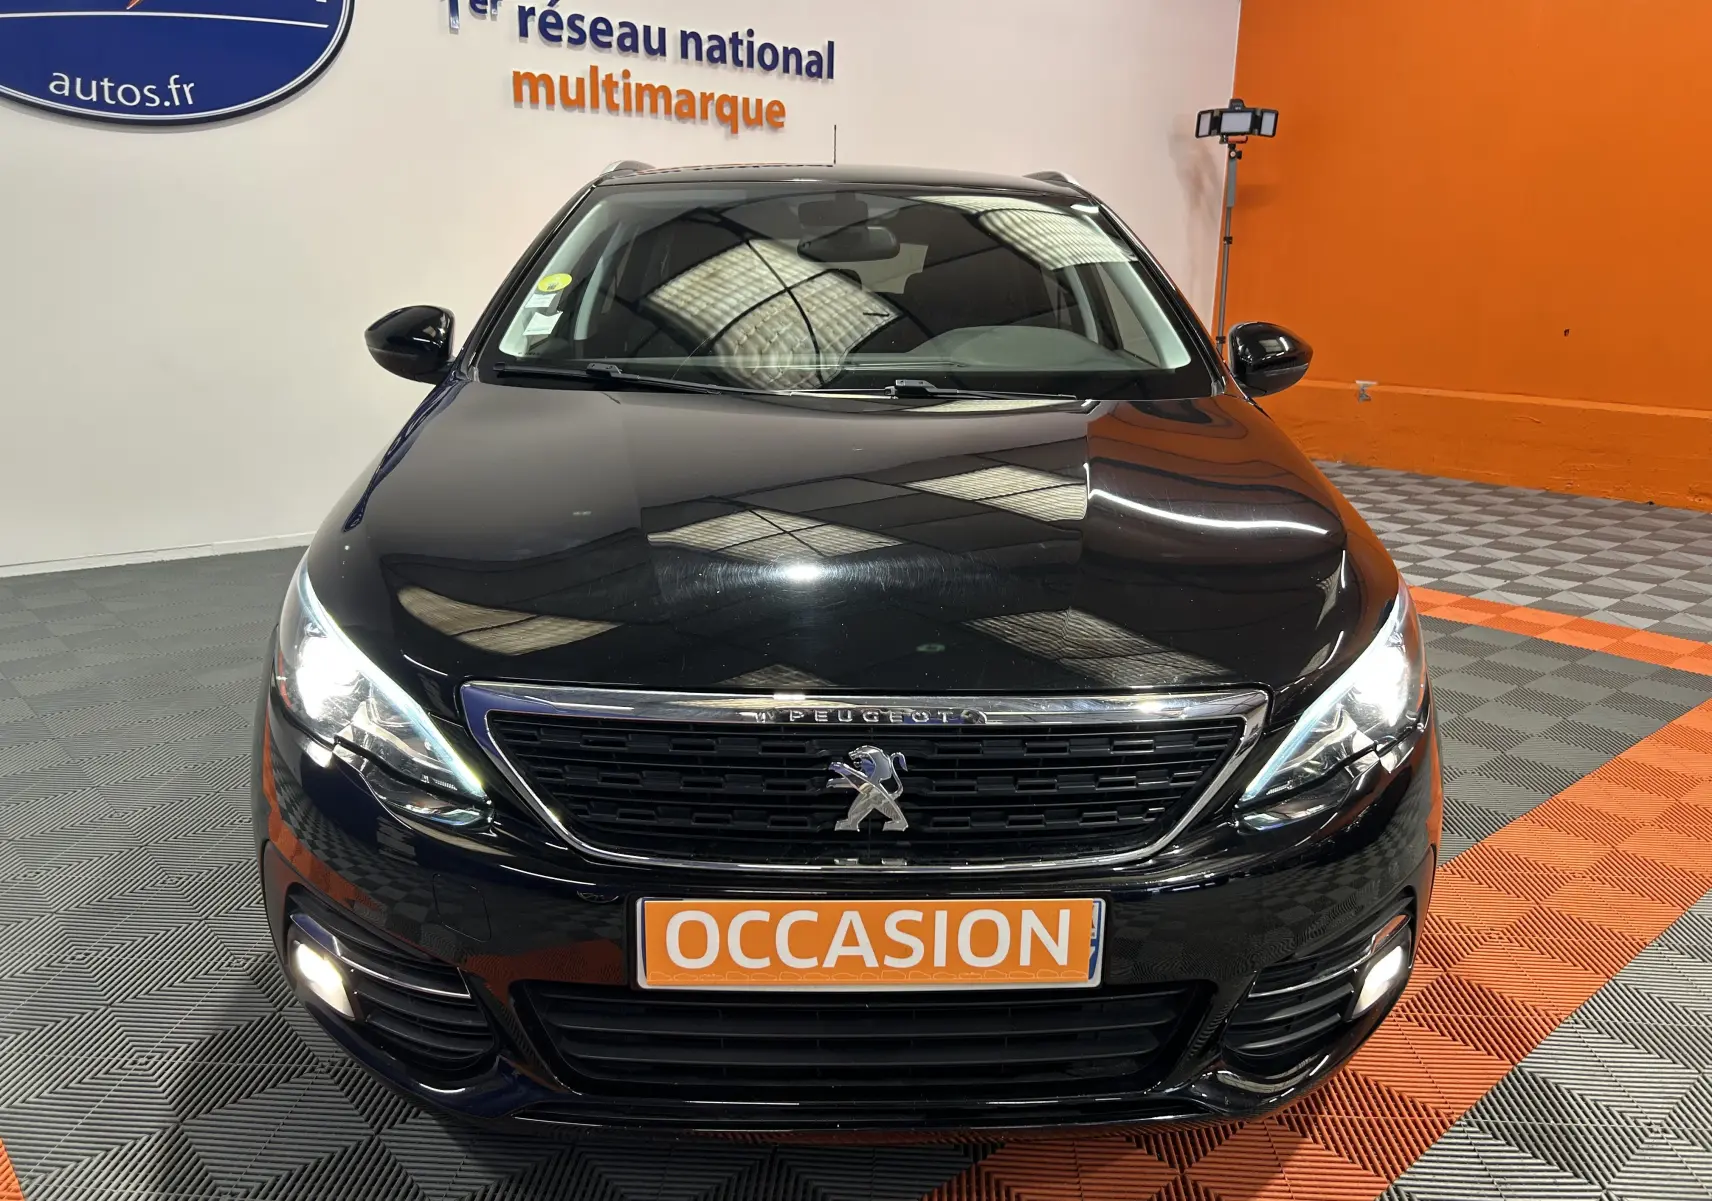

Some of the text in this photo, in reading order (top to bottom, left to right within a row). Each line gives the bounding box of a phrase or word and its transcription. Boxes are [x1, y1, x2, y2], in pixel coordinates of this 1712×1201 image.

[518, 0, 666, 57] réseau
[680, 28, 834, 80] national
[49, 72, 195, 107] autos.fr
[513, 65, 785, 134] multimarque
[789, 709, 954, 723] PEUGEOT
[665, 908, 1070, 969] OCCASION
